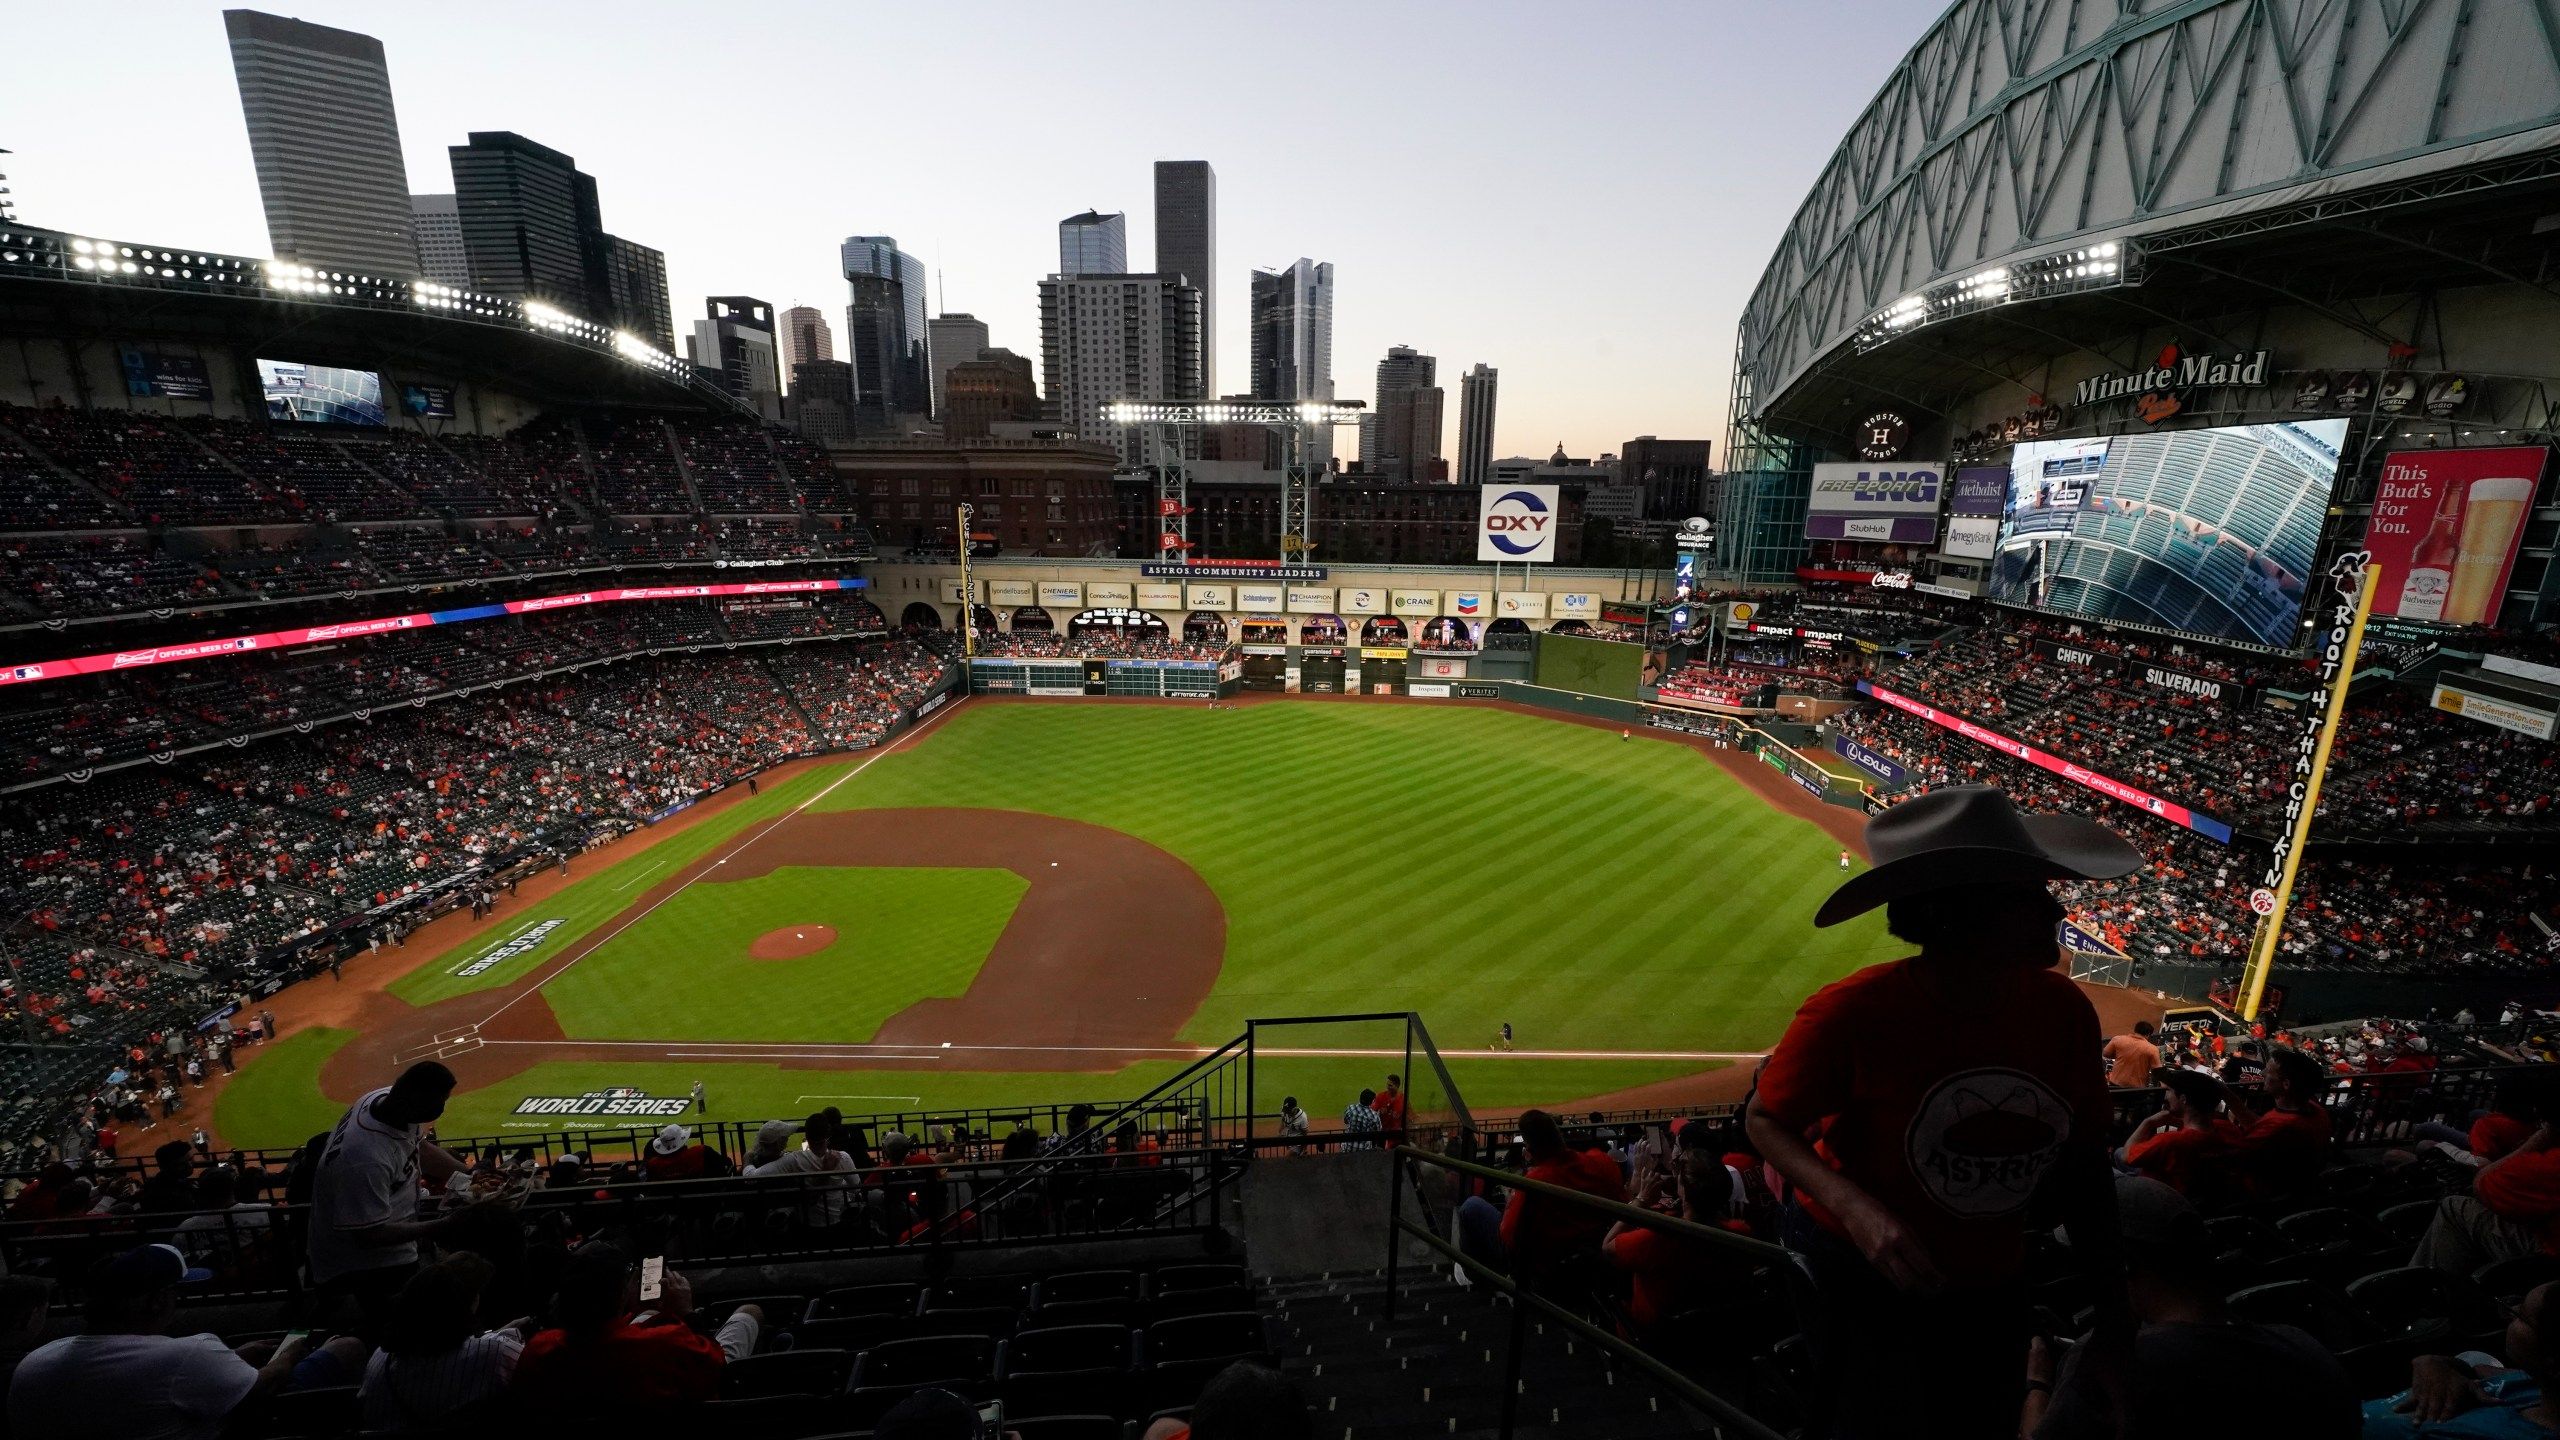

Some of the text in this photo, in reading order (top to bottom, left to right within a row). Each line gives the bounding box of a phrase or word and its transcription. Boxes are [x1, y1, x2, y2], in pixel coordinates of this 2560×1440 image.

[2073, 351, 2267, 407] Minute Maid
[1864, 413, 1904, 428] HOUSTON
[1871, 428, 1890, 445] H
[1861, 446, 1898, 459] ASTROS
[2386, 464, 2428, 481] This
[1818, 480, 1918, 492] FREEPORT
[1854, 471, 1939, 502] LNG
[1957, 481, 2002, 498] Methodist
[2381, 483, 2432, 499] Bud's
[1164, 503, 1174, 512] 19
[2377, 501, 2409, 516] For
[1486, 515, 1549, 532] OXY
[1849, 523, 1886, 534] StubHub
[2373, 517, 2411, 535] You.
[1164, 536, 1175, 546] 05
[1287, 538, 1297, 548] 17
[1675, 532, 1714, 542] Gallagher
[1677, 541, 1710, 549] INSURANCE
[729, 560, 766, 568] Gallagher
[1148, 566, 1321, 578] ASTROS COMMUNITY LEADERS
[1042, 588, 1078, 596] CHENIERE
[1089, 592, 1129, 600] ConocoPhillips
[1243, 594, 1277, 604] Schlumberger
[968, 592, 977, 627] FAIR
[1406, 598, 1434, 606] CRANE
[340, 625, 369, 634] OFFICIAL
[1757, 625, 1793, 637] impact
[1804, 630, 1843, 642] impact
[159, 647, 197, 659] OFFICIAL
[200, 644, 221, 654] BEER
[223, 642, 234, 650] OF
[2322, 605, 2352, 681] ROOT
[2056, 647, 2094, 667] CHEVY
[1467, 687, 1497, 695] VERITEX
[2146, 668, 2221, 700] SILVERADO
[2311, 689, 2328, 709] 4
[2439, 694, 2462, 709] smile
[2466, 699, 2546, 730] SmileGeneration.com
[1977, 730, 1998, 745] OFFICIAL
[2296, 715, 2325, 775] THA
[1857, 750, 1892, 778] LEXUS
[2091, 777, 2118, 794] OFFICIAL
[2118, 787, 2136, 800] BEER
[2136, 794, 2146, 805] OF
[2265, 782, 2305, 888] CHIKIN
[457, 919, 566, 976] WORLD SERIES
[515, 1099, 691, 1115] WORLD SERIES
